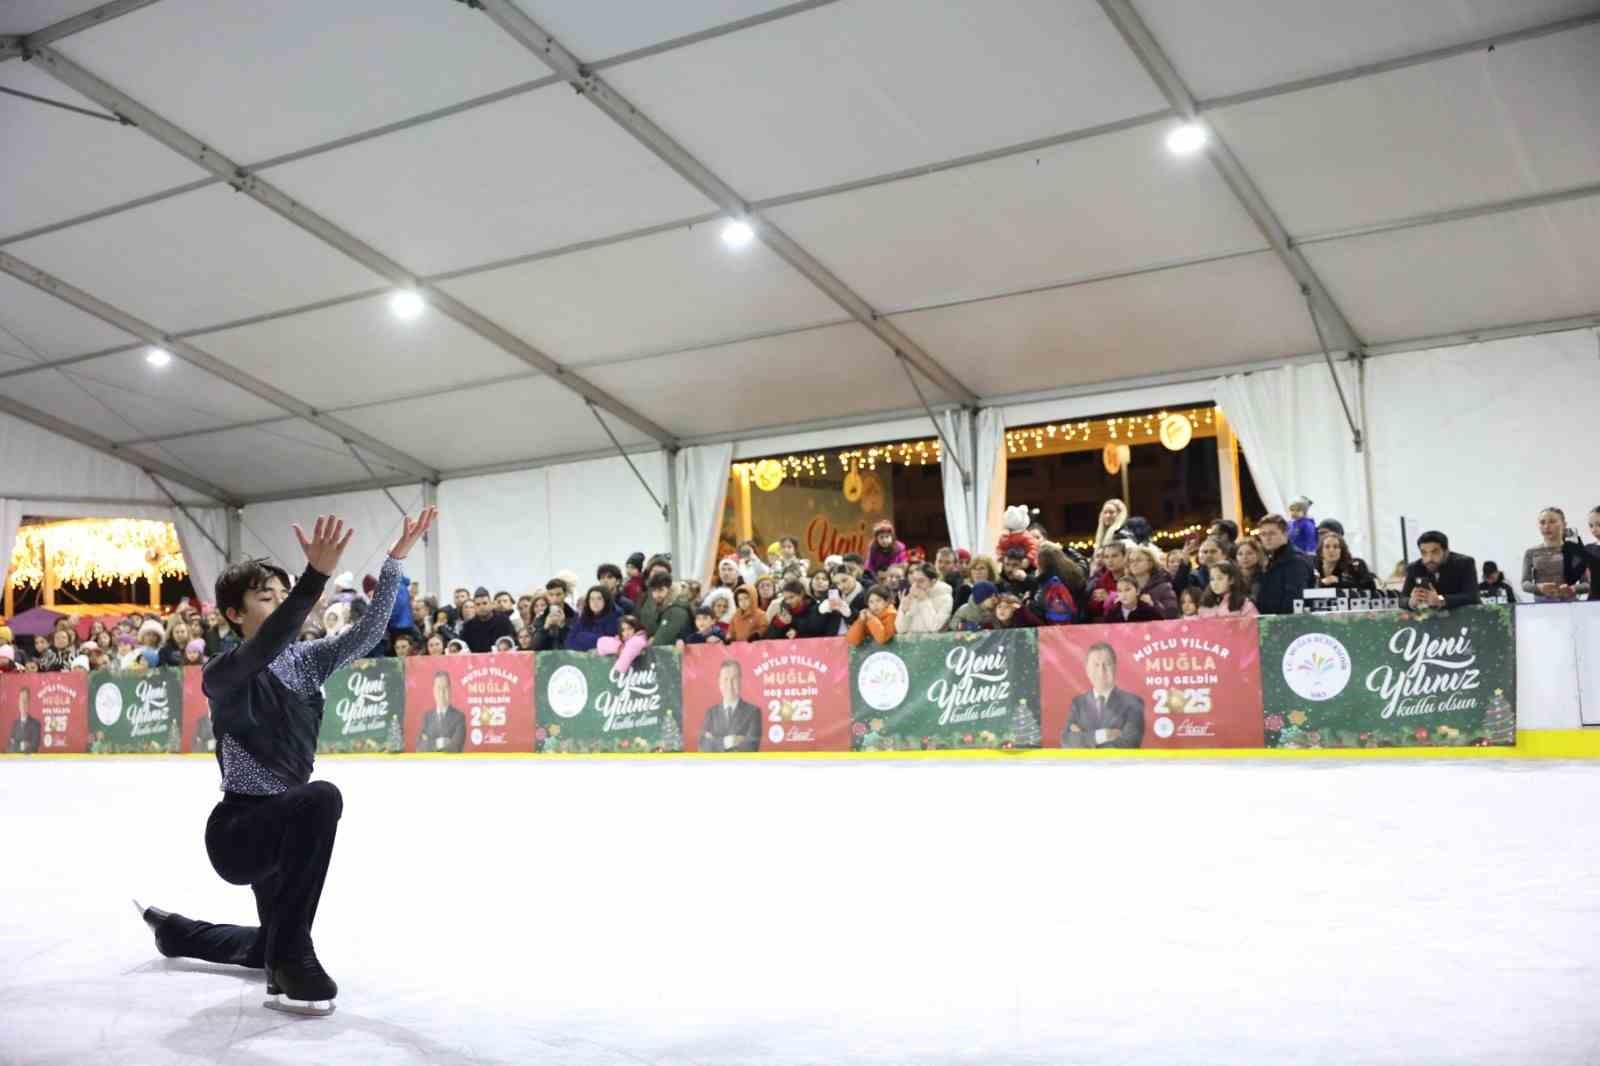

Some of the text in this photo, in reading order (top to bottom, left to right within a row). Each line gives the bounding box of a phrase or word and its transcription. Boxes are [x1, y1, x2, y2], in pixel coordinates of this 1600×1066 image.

[1133, 638, 1230, 661] MUTLU YILLAR
[1389, 627, 1476, 673] Yeni
[946, 646, 1008, 688] Yeni
[1145, 652, 1217, 671] MUĞLA
[1146, 674, 1218, 687] HOŞ GELDİN
[1396, 696, 1477, 717] kutlu olsun
